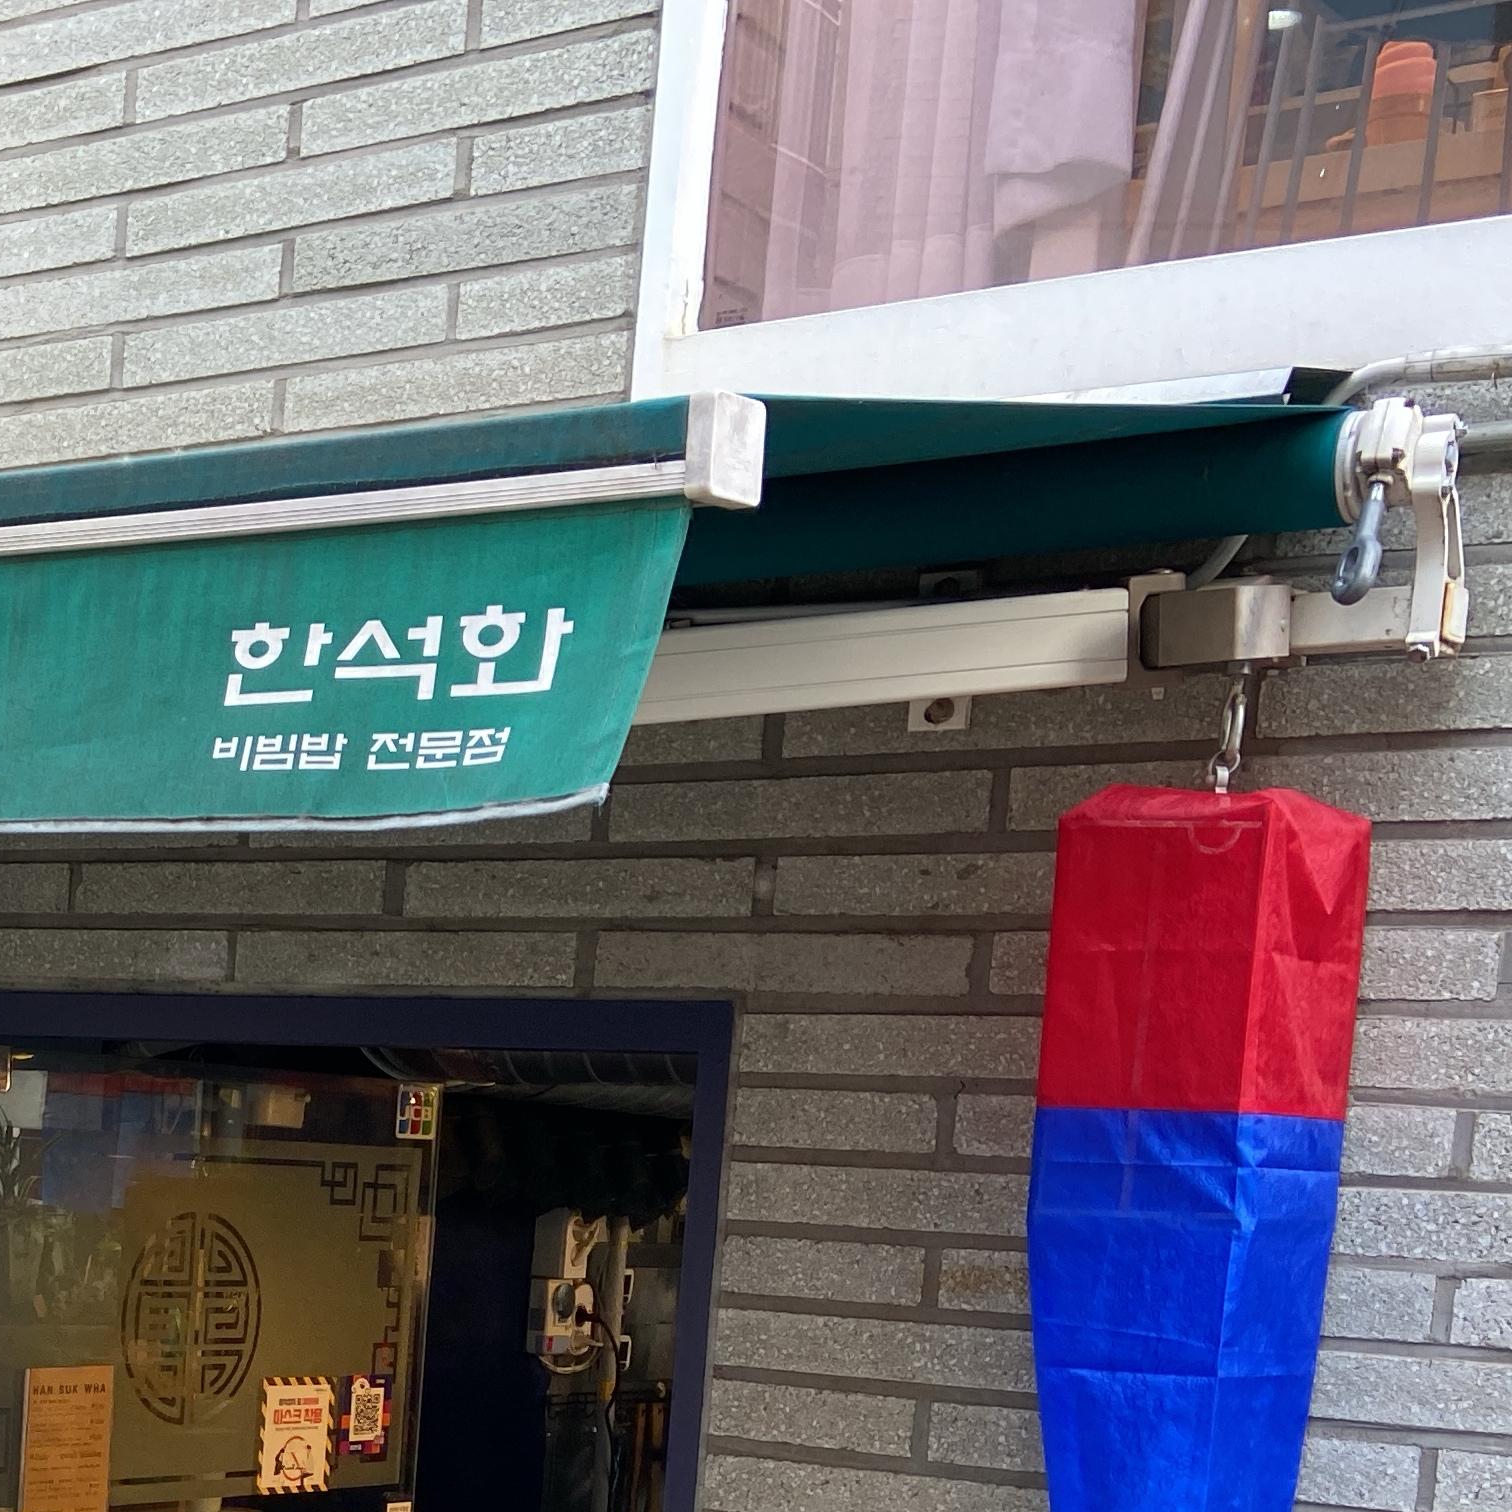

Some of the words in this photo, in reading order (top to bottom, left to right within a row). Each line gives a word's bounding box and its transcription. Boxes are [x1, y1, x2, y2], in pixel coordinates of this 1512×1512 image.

[223, 605, 575, 707] 한석화
[212, 733, 348, 772] 비빔밥
[367, 727, 512, 771] 전문점
[33, 1384, 53, 1396] HAN
[59, 1384, 78, 1395] SUK
[84, 1382, 106, 1394] WHA
